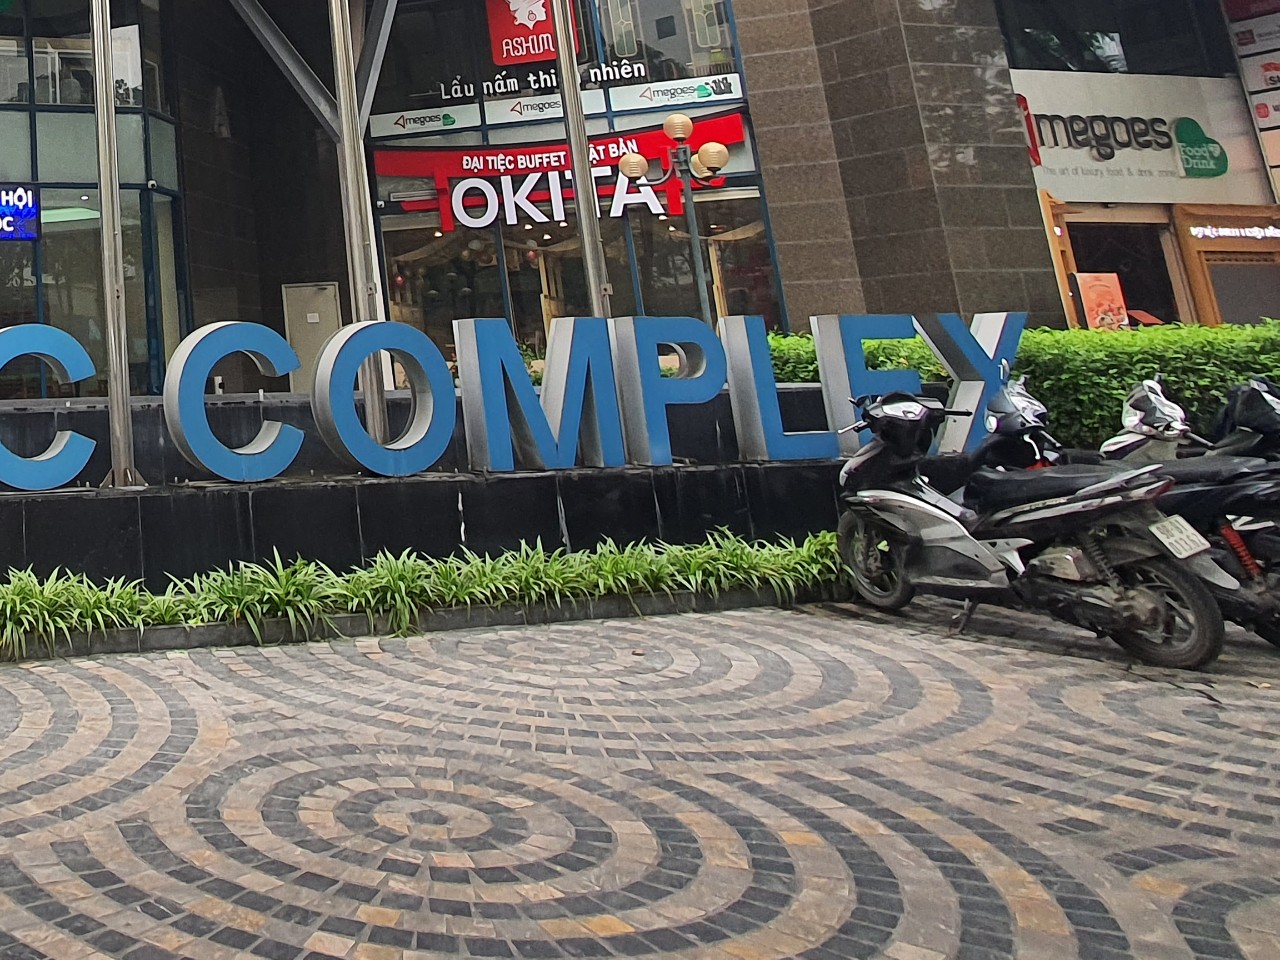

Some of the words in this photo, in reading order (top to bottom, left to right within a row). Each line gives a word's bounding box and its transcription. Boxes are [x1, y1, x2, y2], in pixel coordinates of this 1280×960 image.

[502, 33, 556, 58] ASHIM
[482, 71, 519, 96] nấm
[588, 58, 646, 82] nhiên
[1180, 143, 1208, 157] Food
[462, 155, 484, 172] ĐẠI
[486, 153, 515, 172] TIỆC
[517, 151, 566, 169] BUFFET
[1183, 156, 1216, 169] Drink
[1, 187, 33, 209] HỘI
